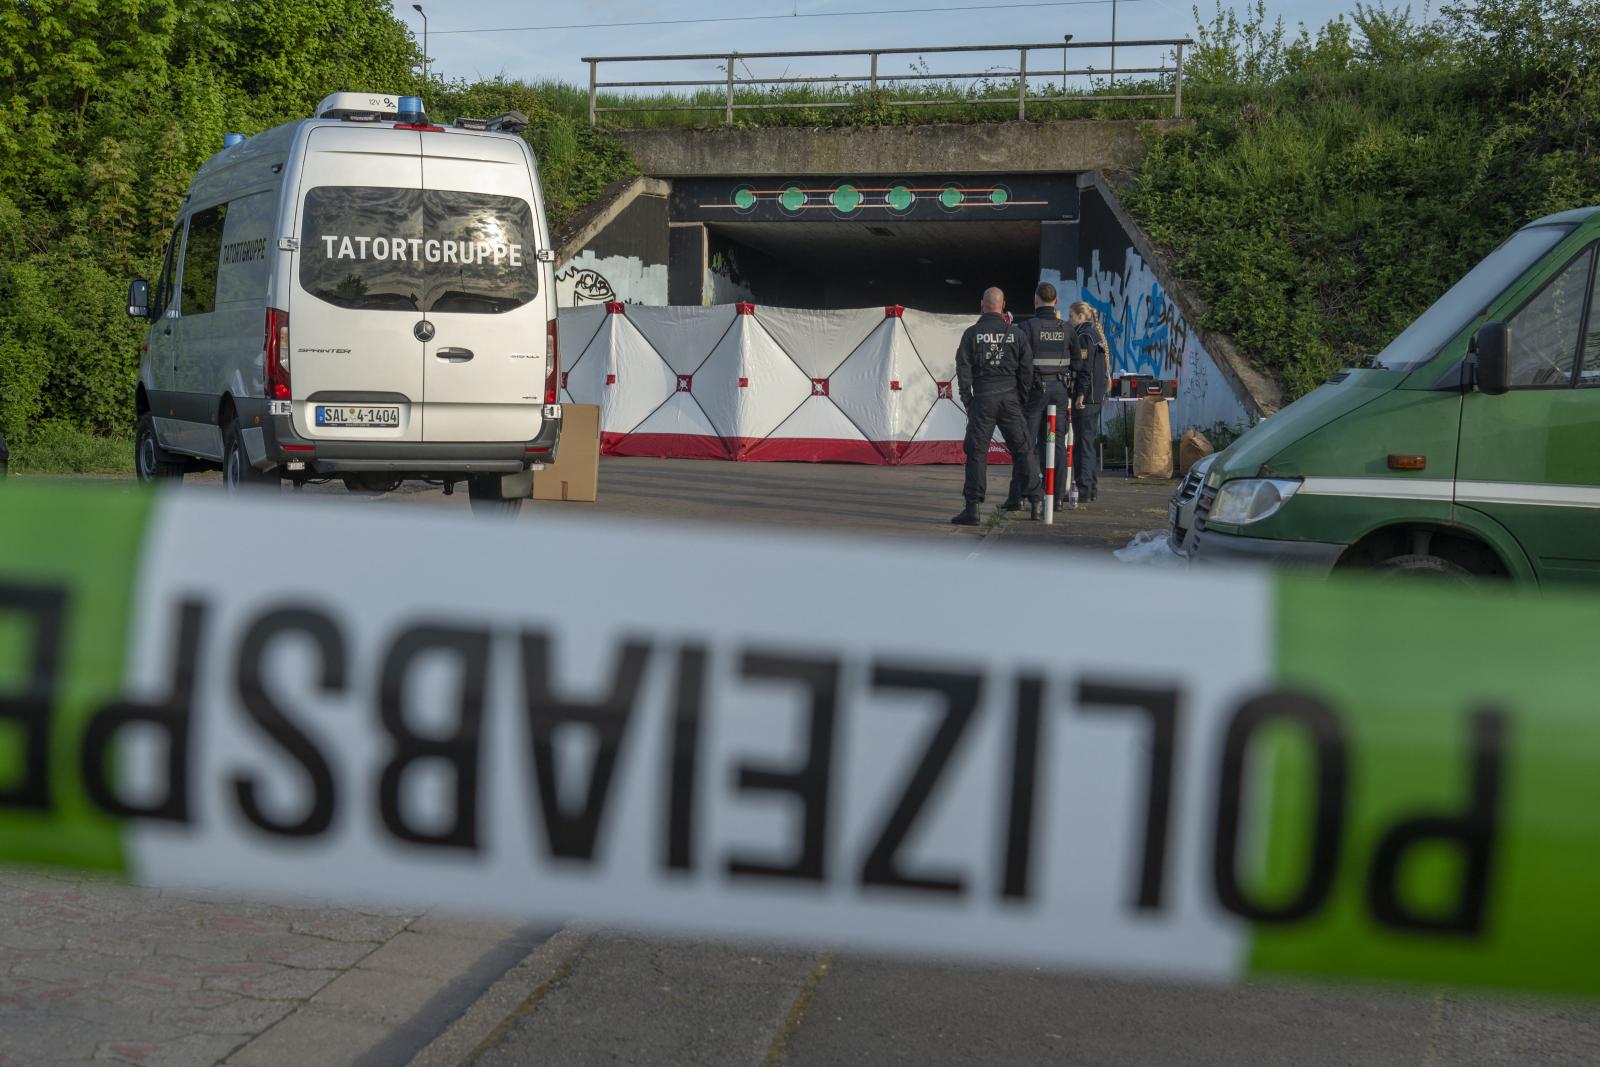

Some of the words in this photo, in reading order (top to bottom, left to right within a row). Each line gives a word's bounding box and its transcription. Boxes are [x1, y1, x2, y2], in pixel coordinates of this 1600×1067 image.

[321, 235, 522, 267] TATORTGRUPPE
[976, 333, 1015, 344] POLIZEI
[1040, 331, 1065, 341] POLIZEI
[325, 408, 348, 422] SAL
[357, 409, 397, 423] 4-1404
